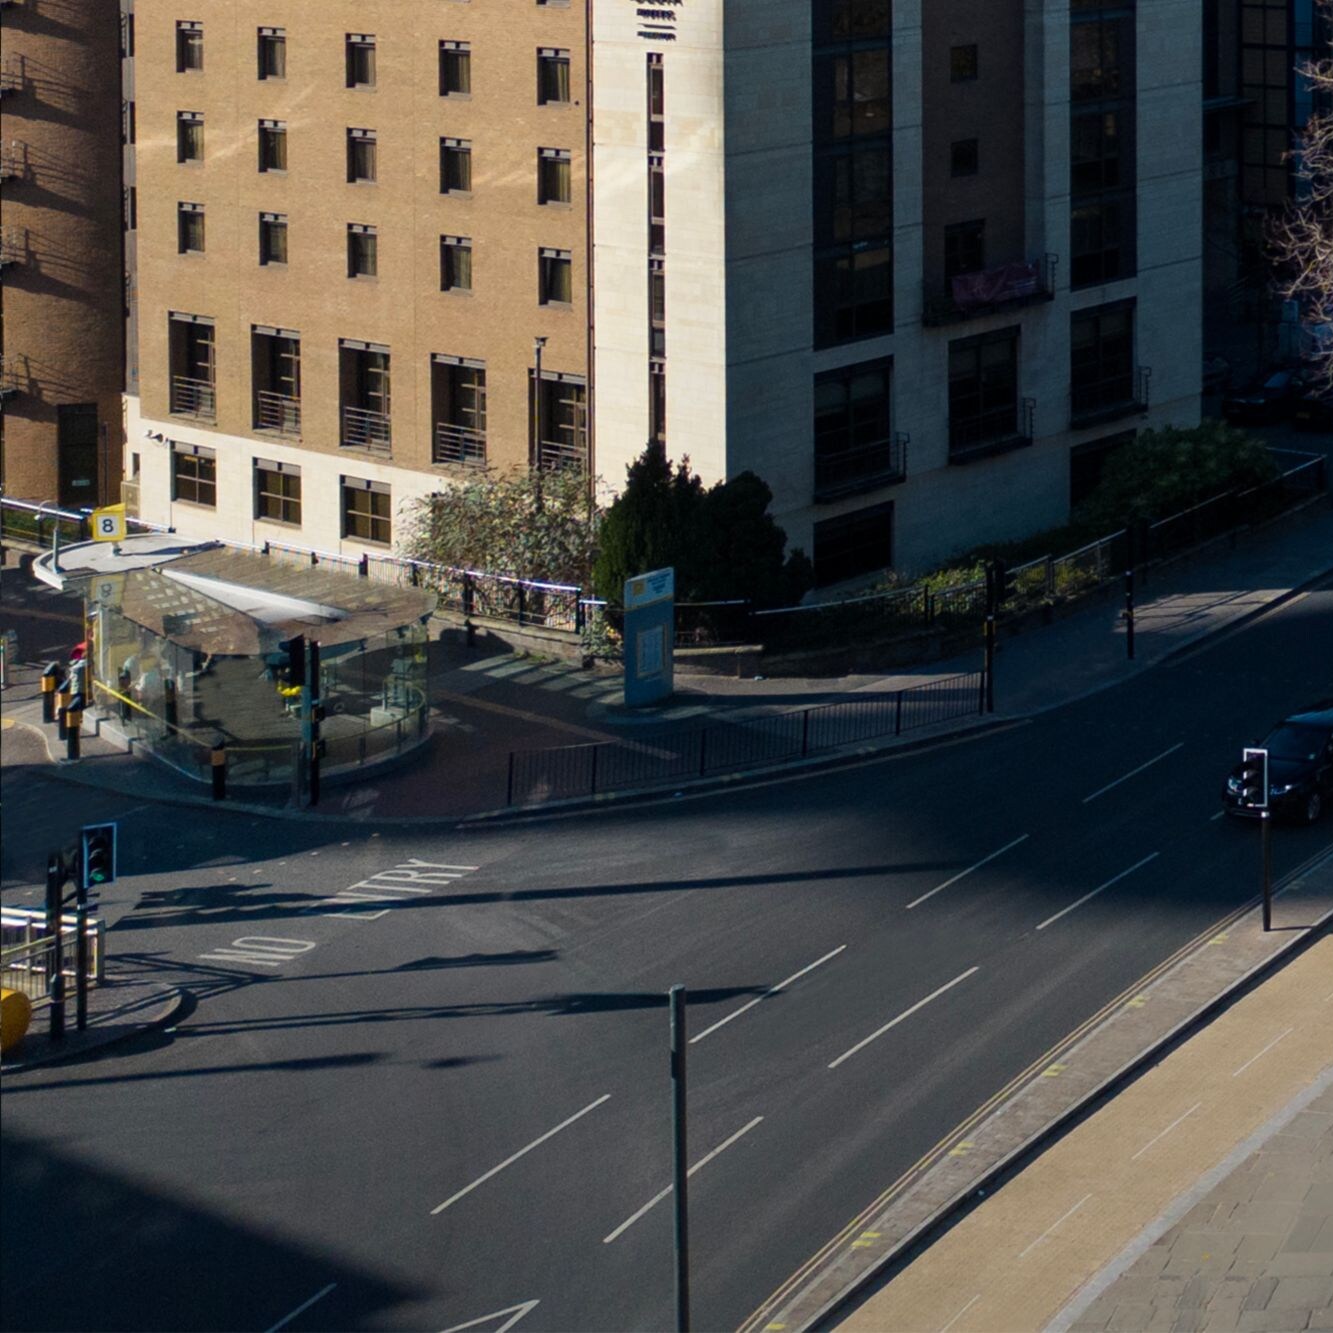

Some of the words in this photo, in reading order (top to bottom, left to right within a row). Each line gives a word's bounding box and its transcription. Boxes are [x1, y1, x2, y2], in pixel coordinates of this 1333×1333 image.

[102, 518, 114, 533] 8
[196, 936, 316, 966] NO
[303, 858, 480, 920] ENTRY
